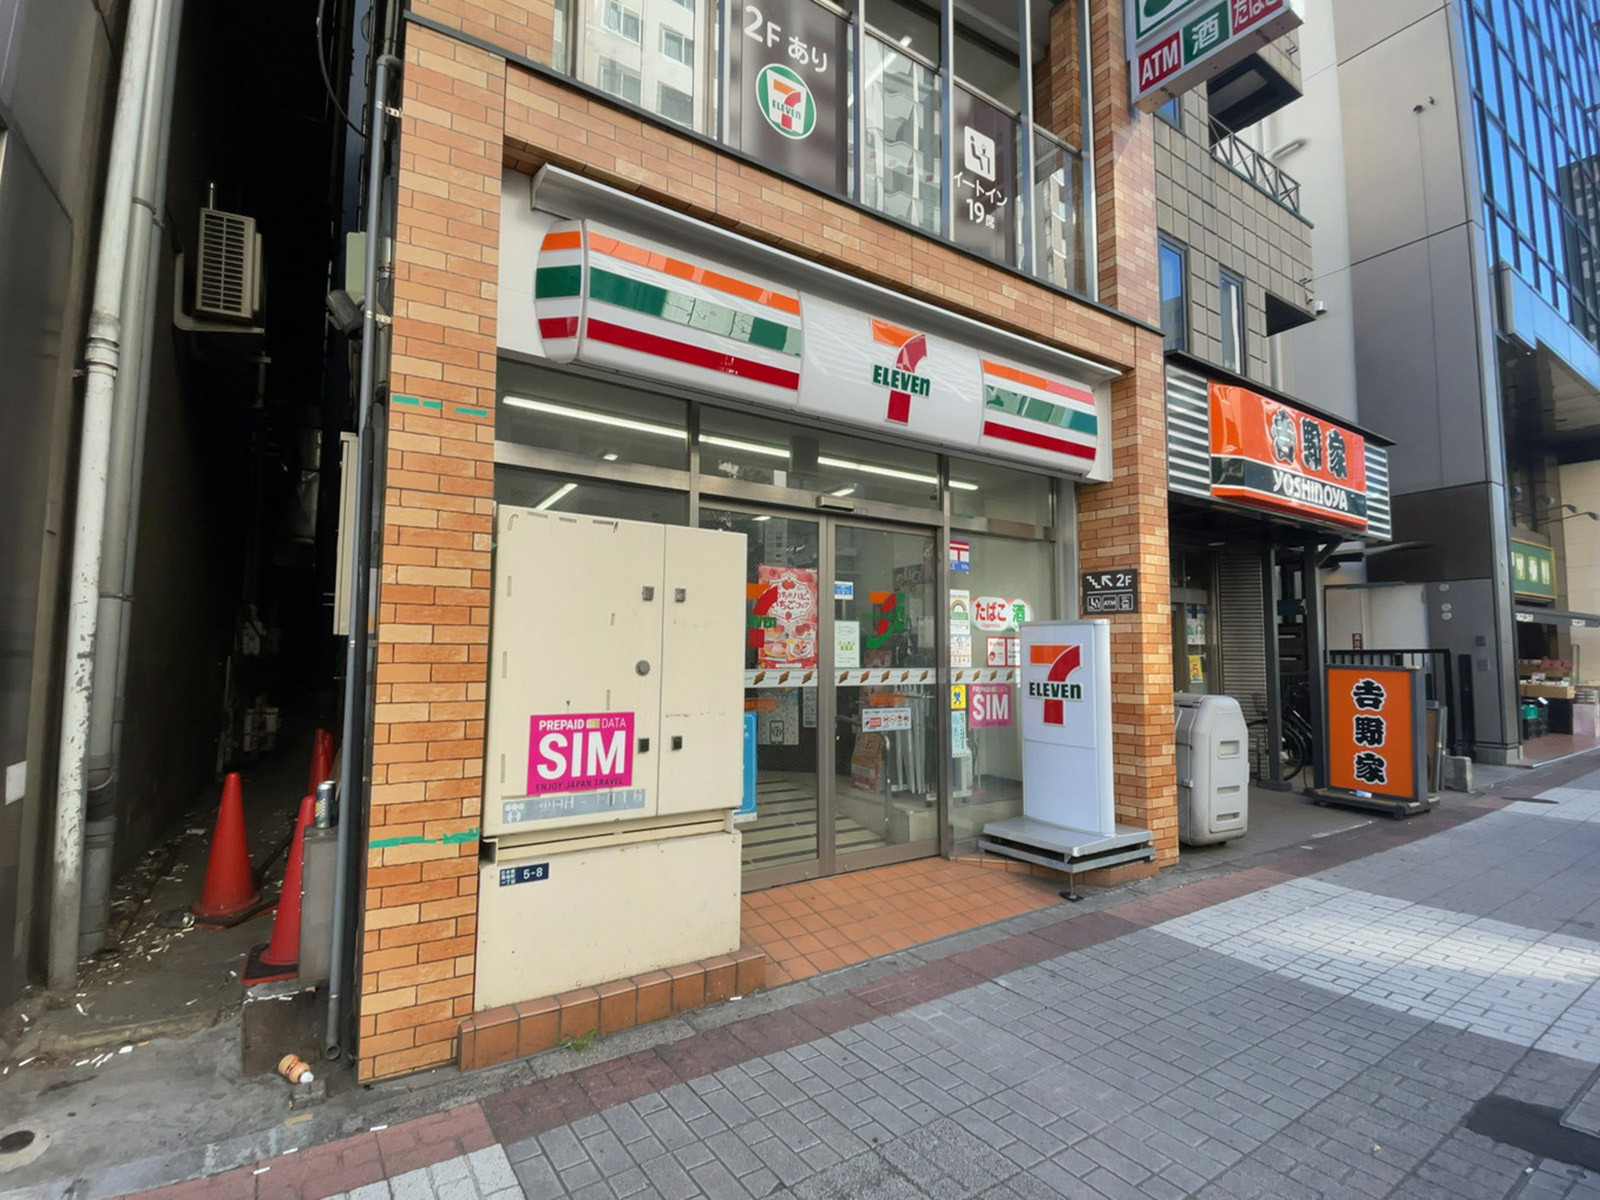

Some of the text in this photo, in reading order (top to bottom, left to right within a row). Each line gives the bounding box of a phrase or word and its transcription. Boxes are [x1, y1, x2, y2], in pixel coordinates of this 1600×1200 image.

[744, 5, 828, 72] 2F あり
[1191, 12, 1219, 55] 酒
[1141, 39, 1179, 86] ATM
[953, 171, 1008, 206] イートイン
[1116, 573, 1132, 587] 2F
[975, 602, 1006, 621] たばこ
[1012, 604, 1025, 622] 酒
[972, 693, 1009, 721] SIM
[539, 717, 627, 731] PREPAID DATA
[536, 729, 626, 780] SIM
[535, 777, 623, 792] ENJOY JAPAN TRAVEL
[523, 866, 543, 880] 5-8
